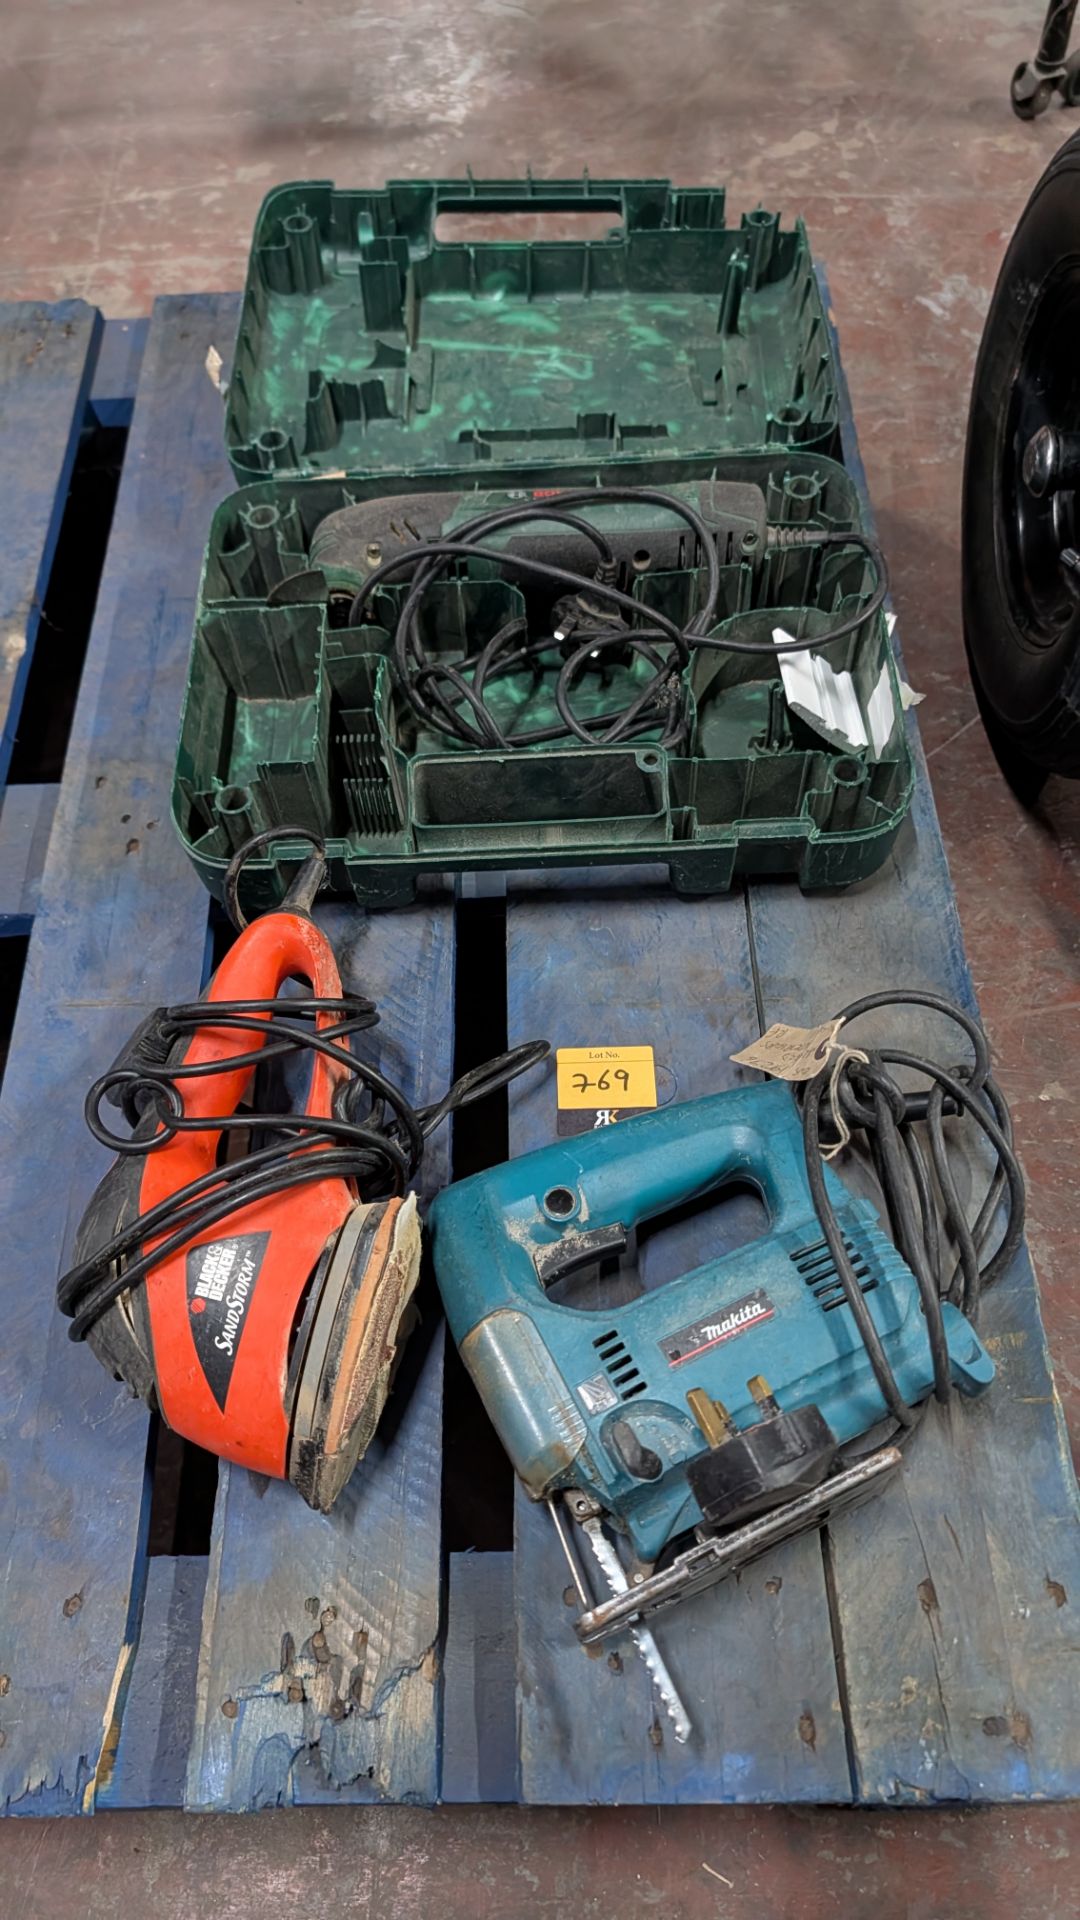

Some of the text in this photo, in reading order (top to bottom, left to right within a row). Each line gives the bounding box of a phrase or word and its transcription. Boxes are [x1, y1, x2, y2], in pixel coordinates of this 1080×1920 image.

[588, 1050, 620, 1059] Lot No.
[572, 1069, 630, 1093] 769
[701, 1300, 767, 1341] Makita
